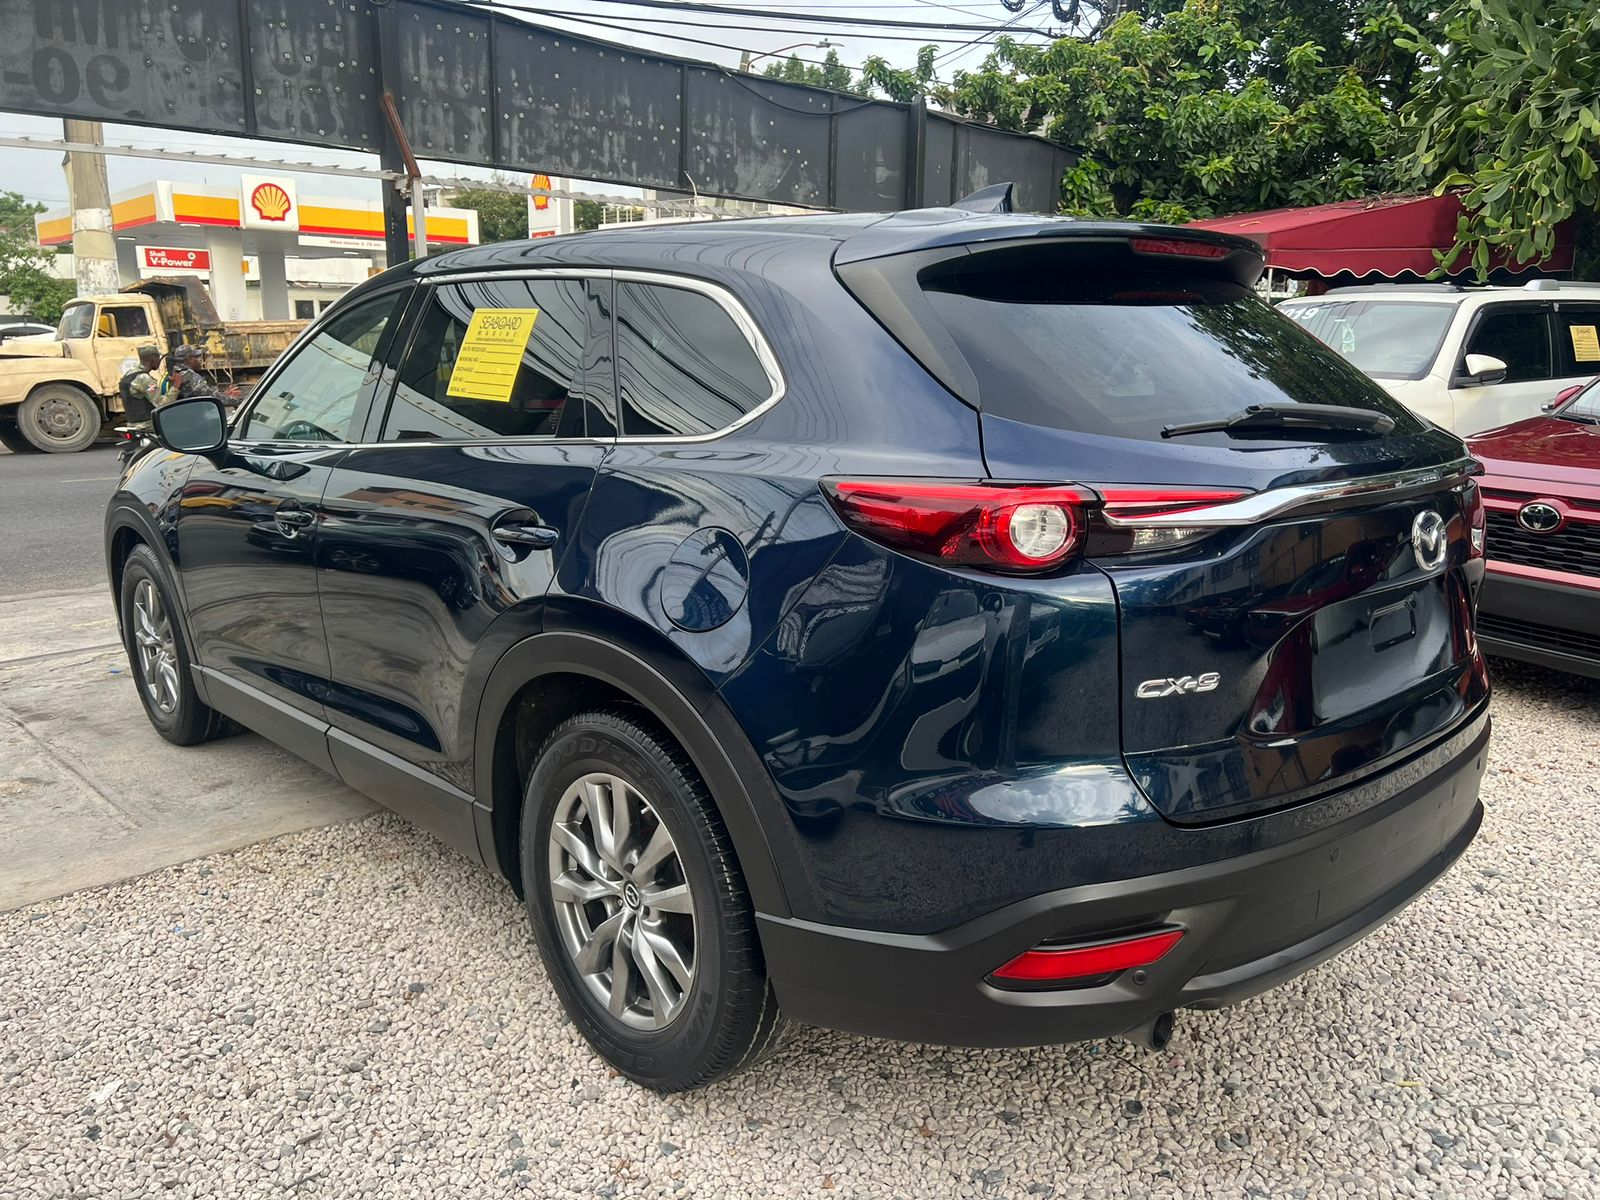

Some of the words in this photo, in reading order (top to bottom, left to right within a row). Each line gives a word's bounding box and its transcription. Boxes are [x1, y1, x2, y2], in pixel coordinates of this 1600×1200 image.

[150, 257, 193, 267] V-Power
[480, 315, 522, 330] SEABOARD
[1135, 671, 1221, 698] CX-9
